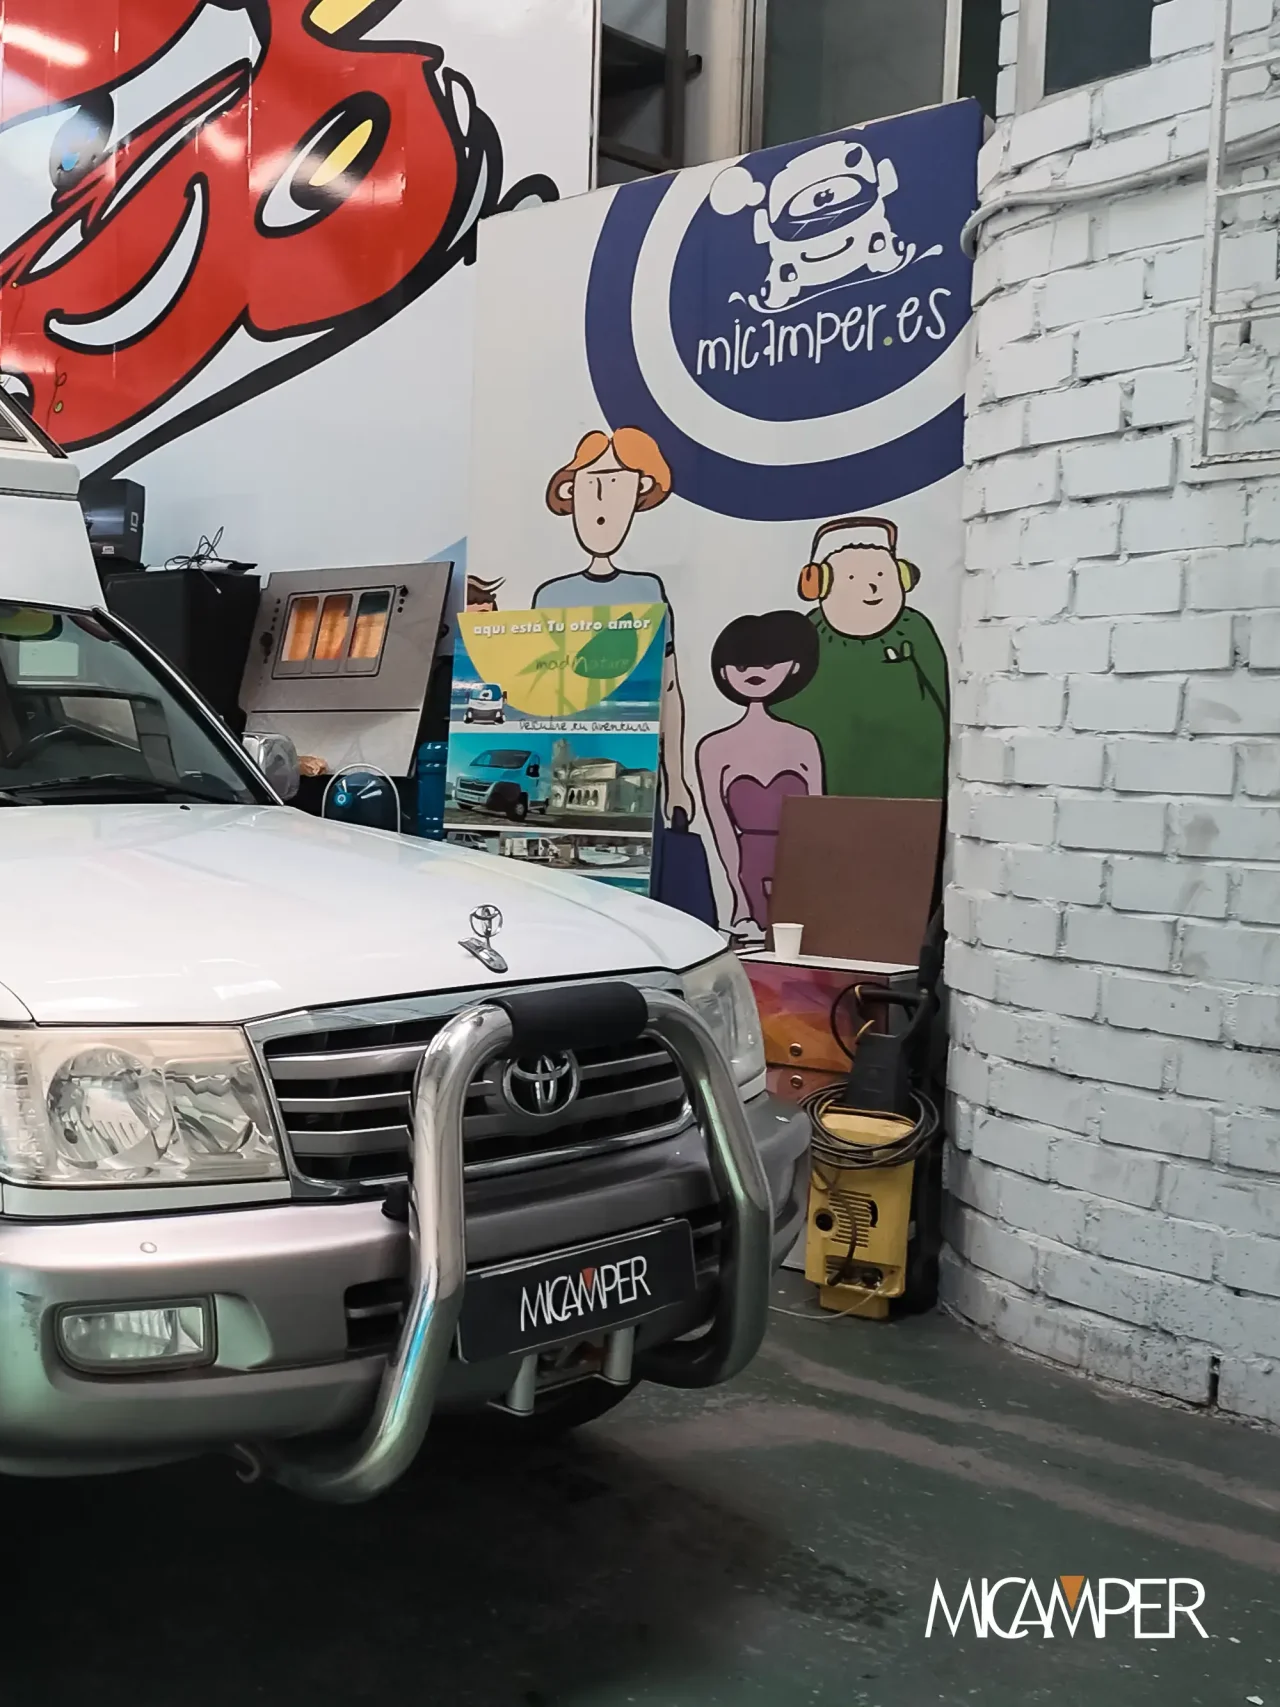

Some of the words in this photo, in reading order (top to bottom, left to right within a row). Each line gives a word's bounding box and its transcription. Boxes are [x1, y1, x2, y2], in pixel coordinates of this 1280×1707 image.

[696, 287, 952, 376] micamper.es
[546, 620, 566, 633] Tu
[569, 619, 603, 632] otro
[607, 618, 652, 631] amor
[519, 1254, 653, 1333] MICAMPER
